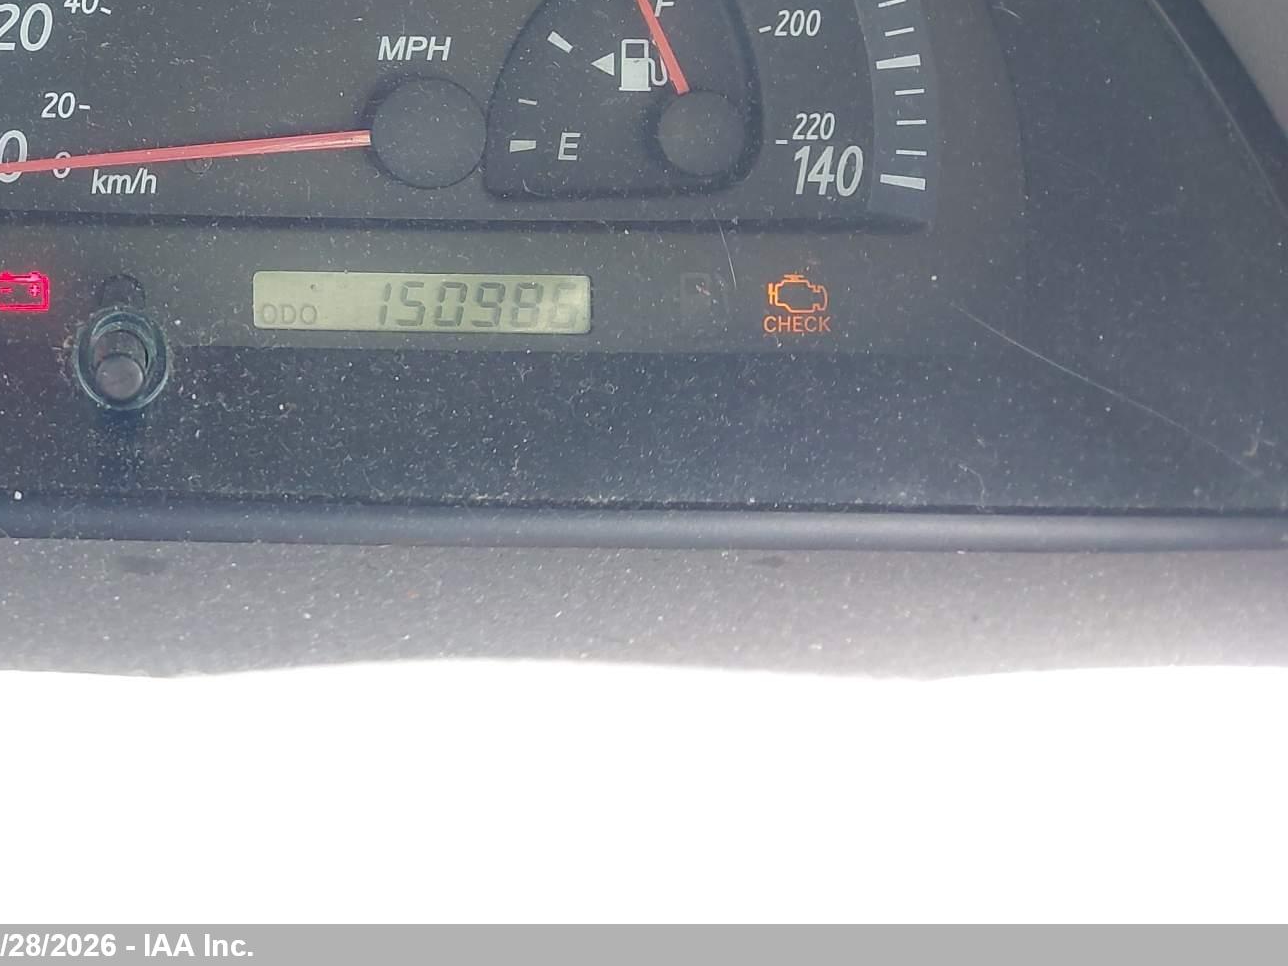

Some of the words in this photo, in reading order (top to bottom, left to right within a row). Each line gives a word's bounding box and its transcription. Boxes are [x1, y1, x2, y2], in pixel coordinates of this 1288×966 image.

[774, 9, 821, 36] 200
[378, 36, 450, 61] MPH
[41, 92, 75, 118] 20
[792, 113, 834, 140] 220
[558, 133, 581, 160] E
[91, 169, 157, 194] km/h
[794, 145, 863, 196] 140
[262, 303, 317, 325] ODO
[764, 316, 831, 332] CHECK
